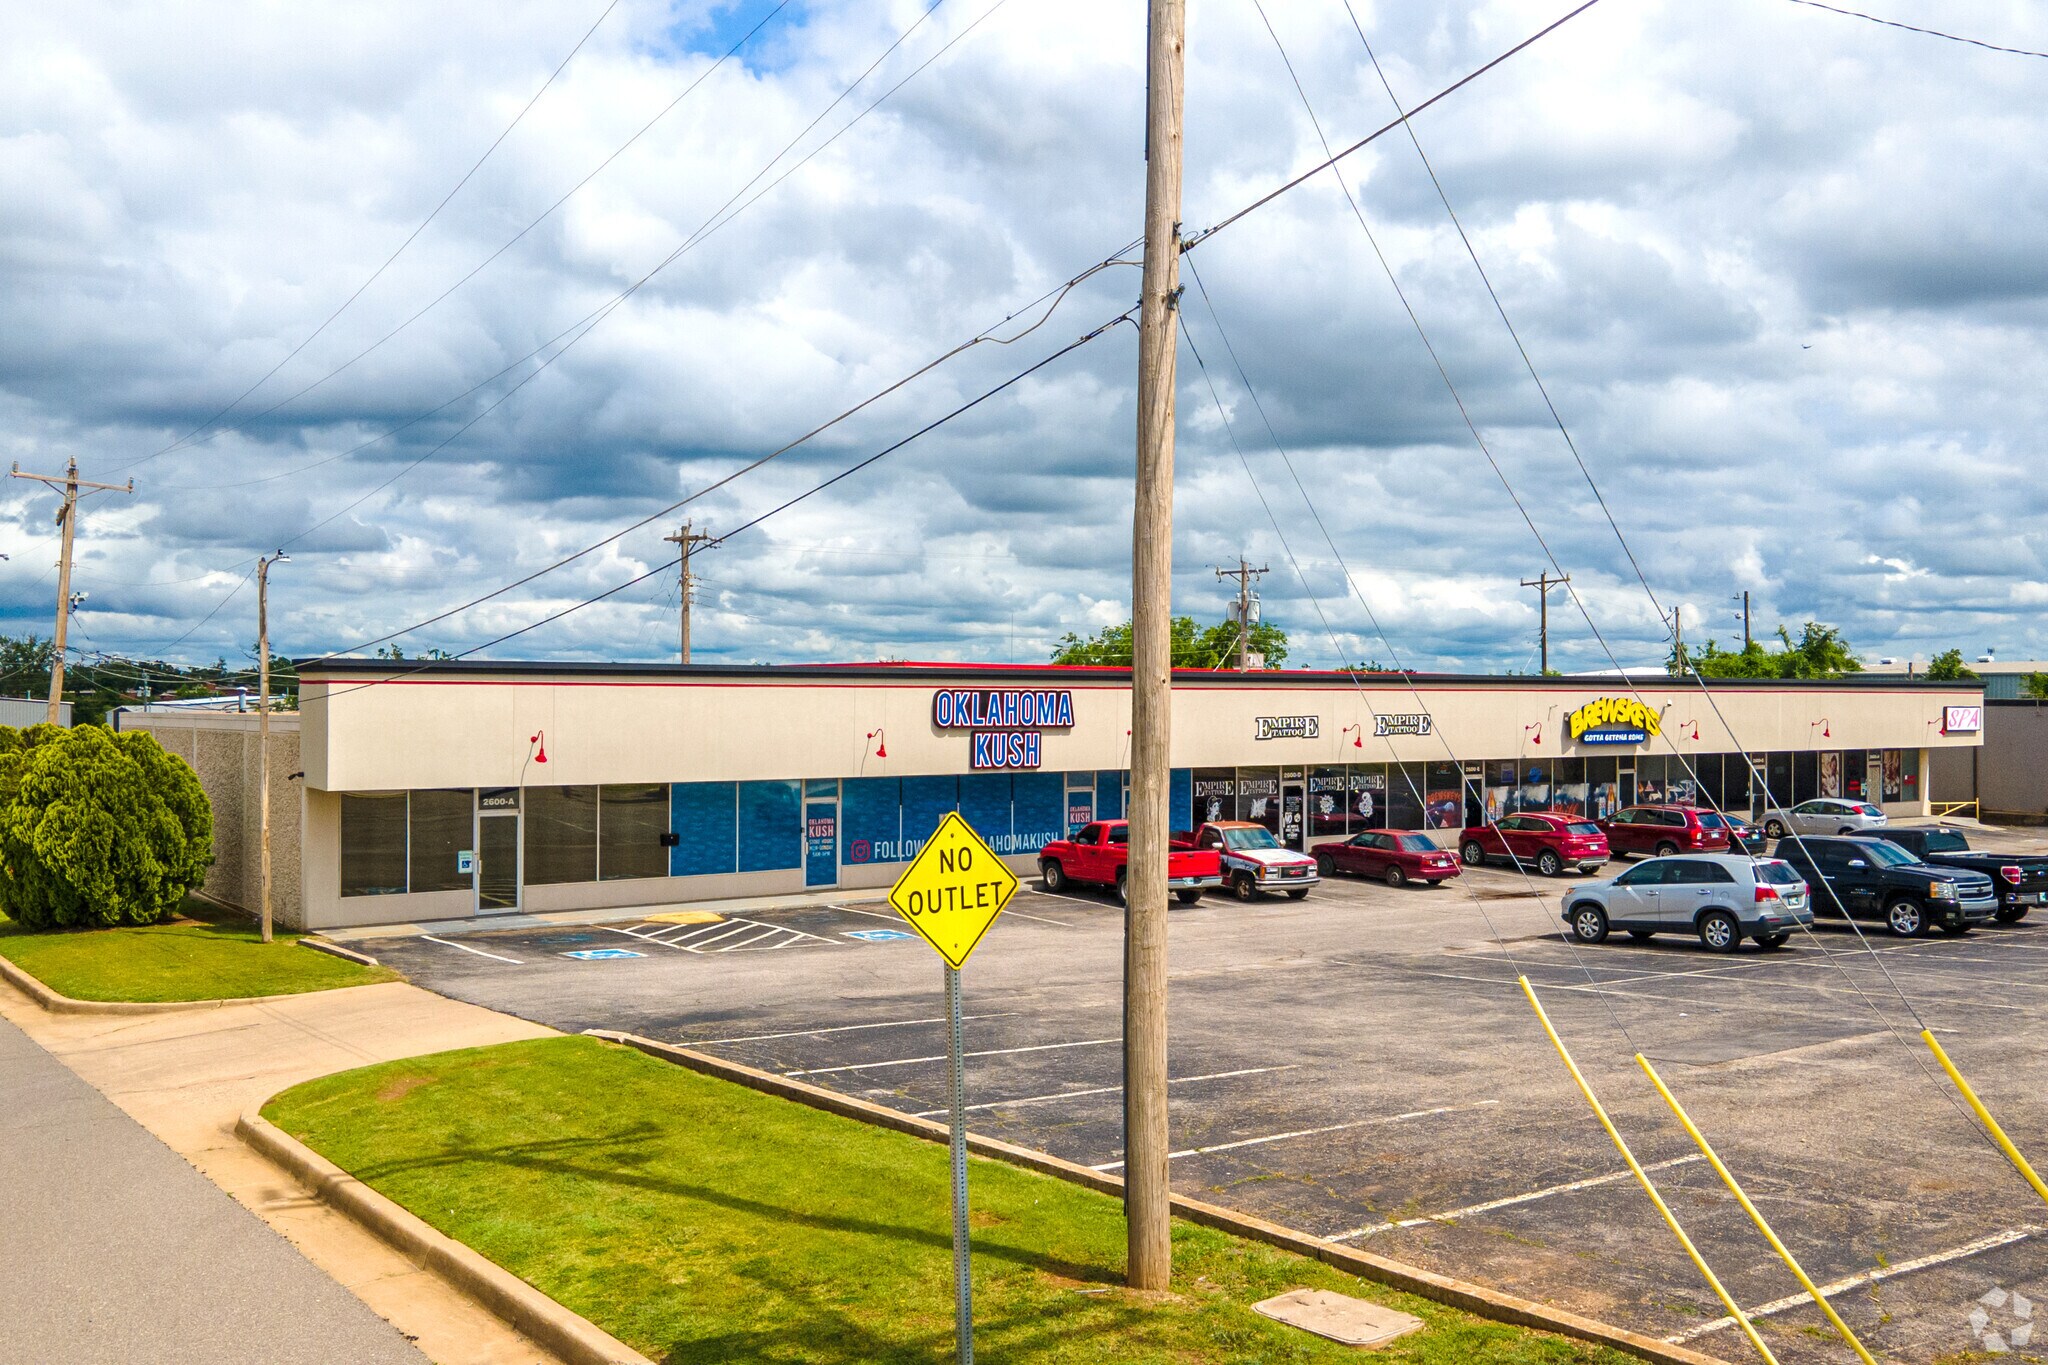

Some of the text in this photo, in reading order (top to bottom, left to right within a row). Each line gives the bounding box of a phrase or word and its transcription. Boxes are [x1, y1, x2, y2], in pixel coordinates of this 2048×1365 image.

[936, 691, 1073, 727] OKLAHOMA
[1374, 714, 1431, 736] EMPIRE
[1948, 709, 1979, 728] SPA
[1256, 716, 1318, 739] EMPIRE
[1271, 729, 1303, 737] TATTOO
[1584, 734, 1604, 742] GOTTA
[975, 732, 1040, 768] KUSH
[1195, 780, 1234, 796] EMPIRE
[1240, 780, 1277, 795] EMPIRE
[1309, 777, 1344, 792] EMPIRE
[1350, 775, 1384, 790] EMPIRE
[483, 798, 515, 806] 2600-A
[1070, 812, 1090, 823] KUSH
[809, 825, 834, 837] KUSH
[979, 832, 1058, 851] AHOMAKUSH
[940, 847, 972, 874] NO
[908, 881, 1003, 916] OUTLET
